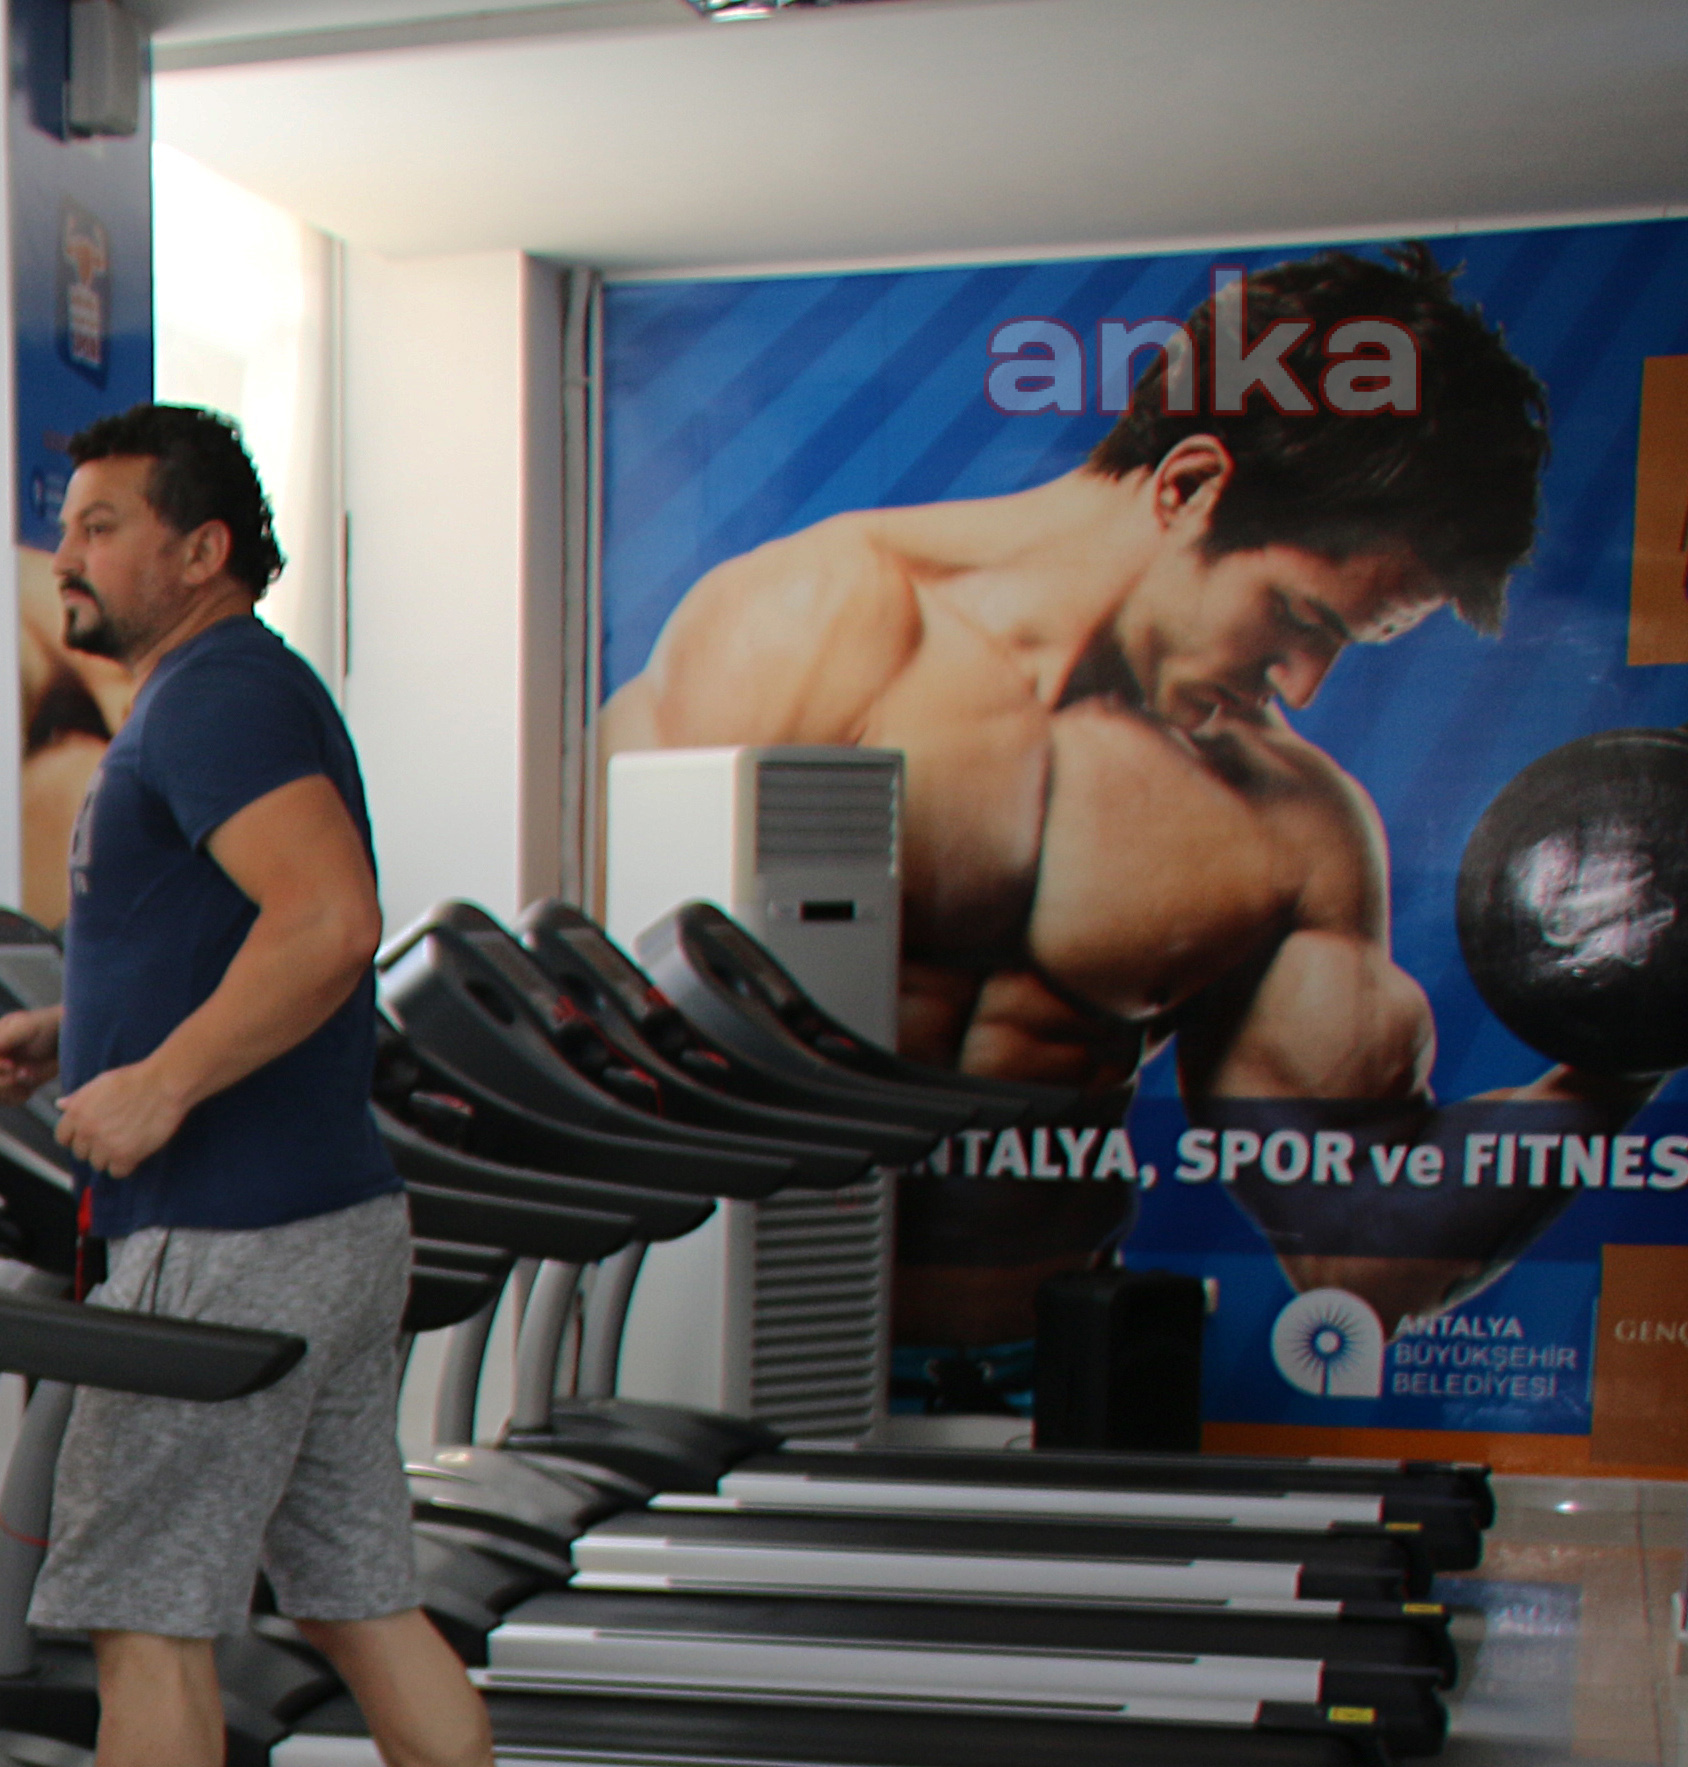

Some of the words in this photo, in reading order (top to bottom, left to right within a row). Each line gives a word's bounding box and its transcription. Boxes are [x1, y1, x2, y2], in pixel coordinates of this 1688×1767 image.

[1173, 1128, 1355, 1185] SPOR
[1370, 1143, 1445, 1187] ve
[1393, 1314, 1525, 1338] ANTALYA
[1392, 1370, 1558, 1398] BELEDİYESİ
